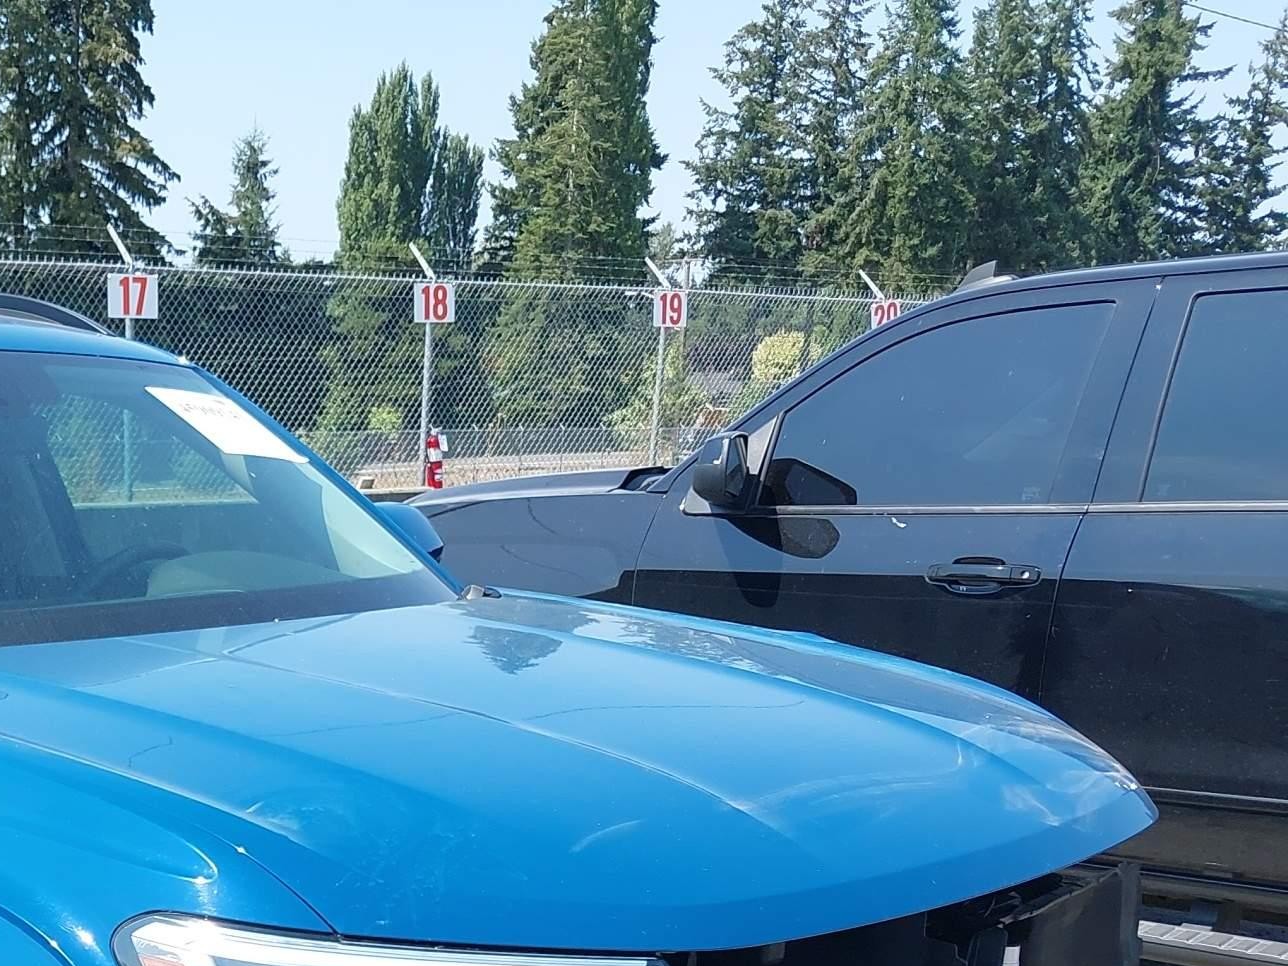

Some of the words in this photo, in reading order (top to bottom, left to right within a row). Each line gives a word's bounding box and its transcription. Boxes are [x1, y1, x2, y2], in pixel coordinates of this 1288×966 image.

[120, 276, 148, 315] 17
[421, 285, 448, 320] 18
[660, 292, 682, 325] 19
[874, 302, 898, 326] 20
